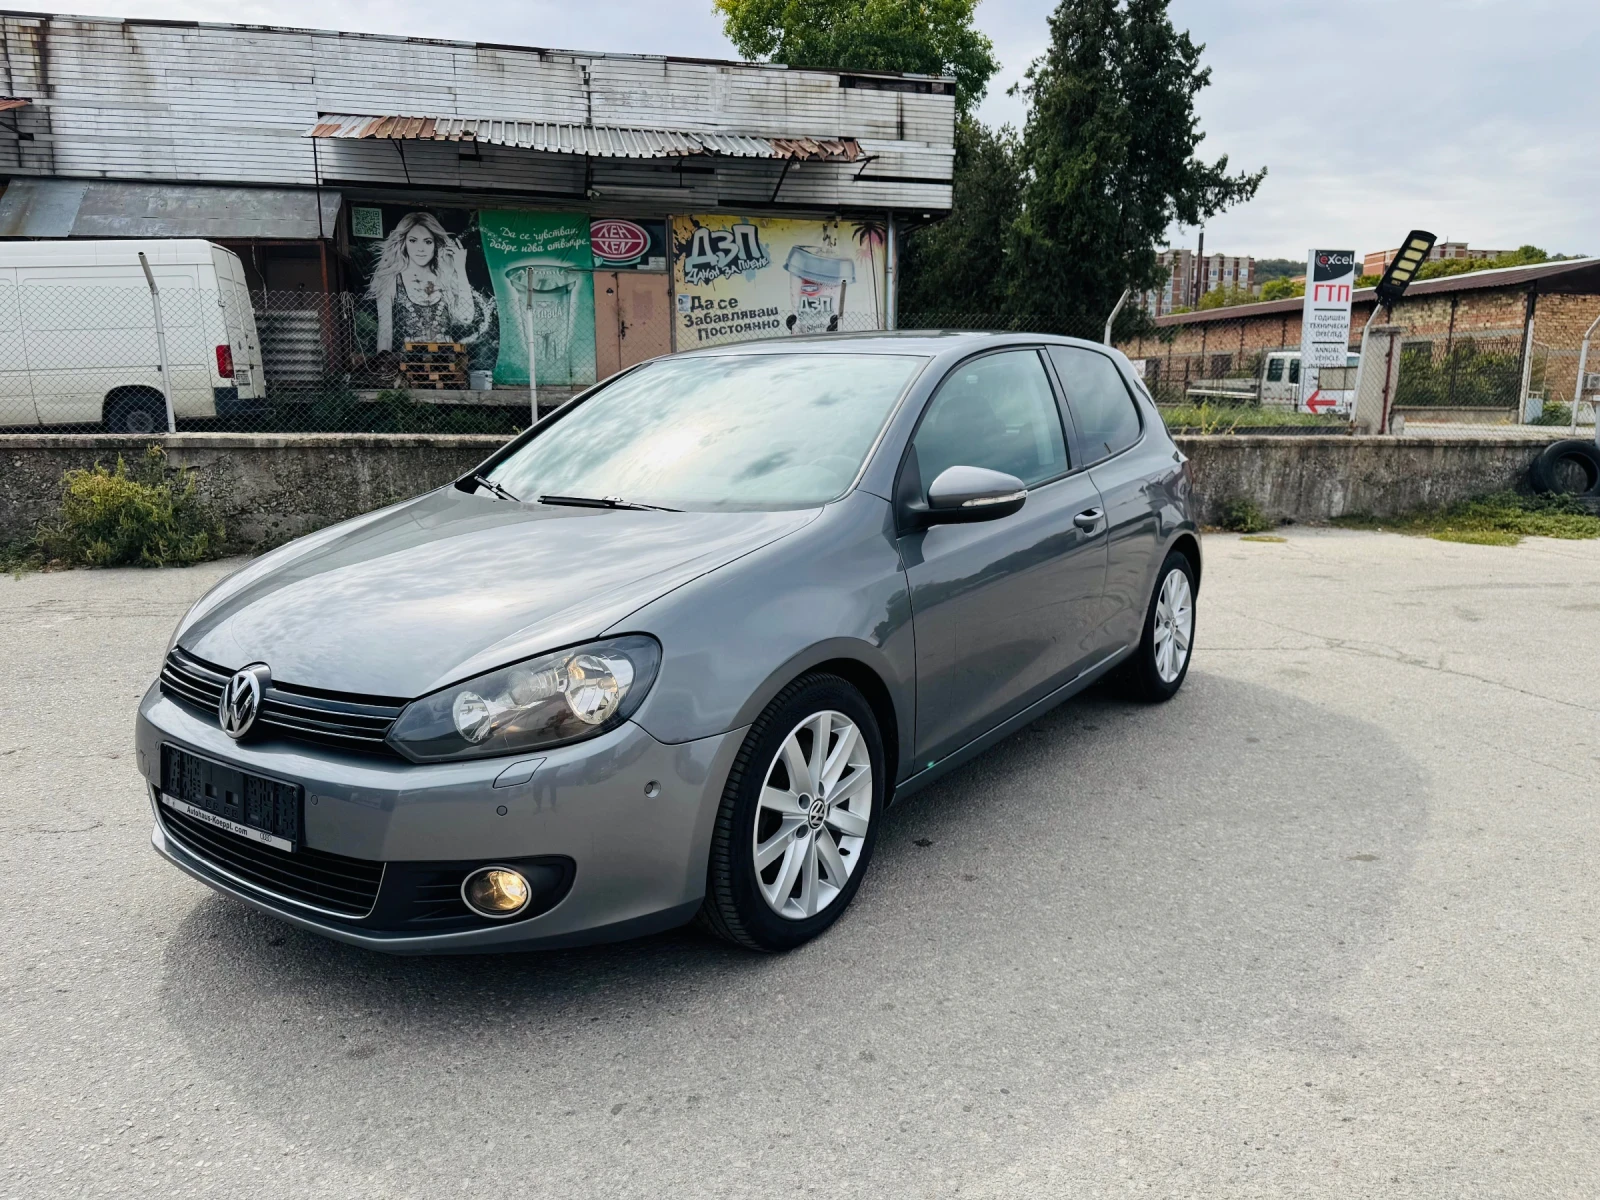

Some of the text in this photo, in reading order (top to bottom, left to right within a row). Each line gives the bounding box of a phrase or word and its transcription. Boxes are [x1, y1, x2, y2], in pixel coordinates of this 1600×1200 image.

[500, 227, 516, 238] Да
[488, 239, 518, 254] добре
[521, 244, 544, 252] идва
[597, 241, 633, 254] KEN
[685, 225, 762, 272] ДЗП
[1314, 284, 1350, 302] ГТП
[690, 296, 714, 312] Да
[717, 297, 738, 309] се
[799, 296, 833, 314] ДЗП
[683, 306, 779, 328] Забавляваш
[697, 319, 780, 341] Постоянно
